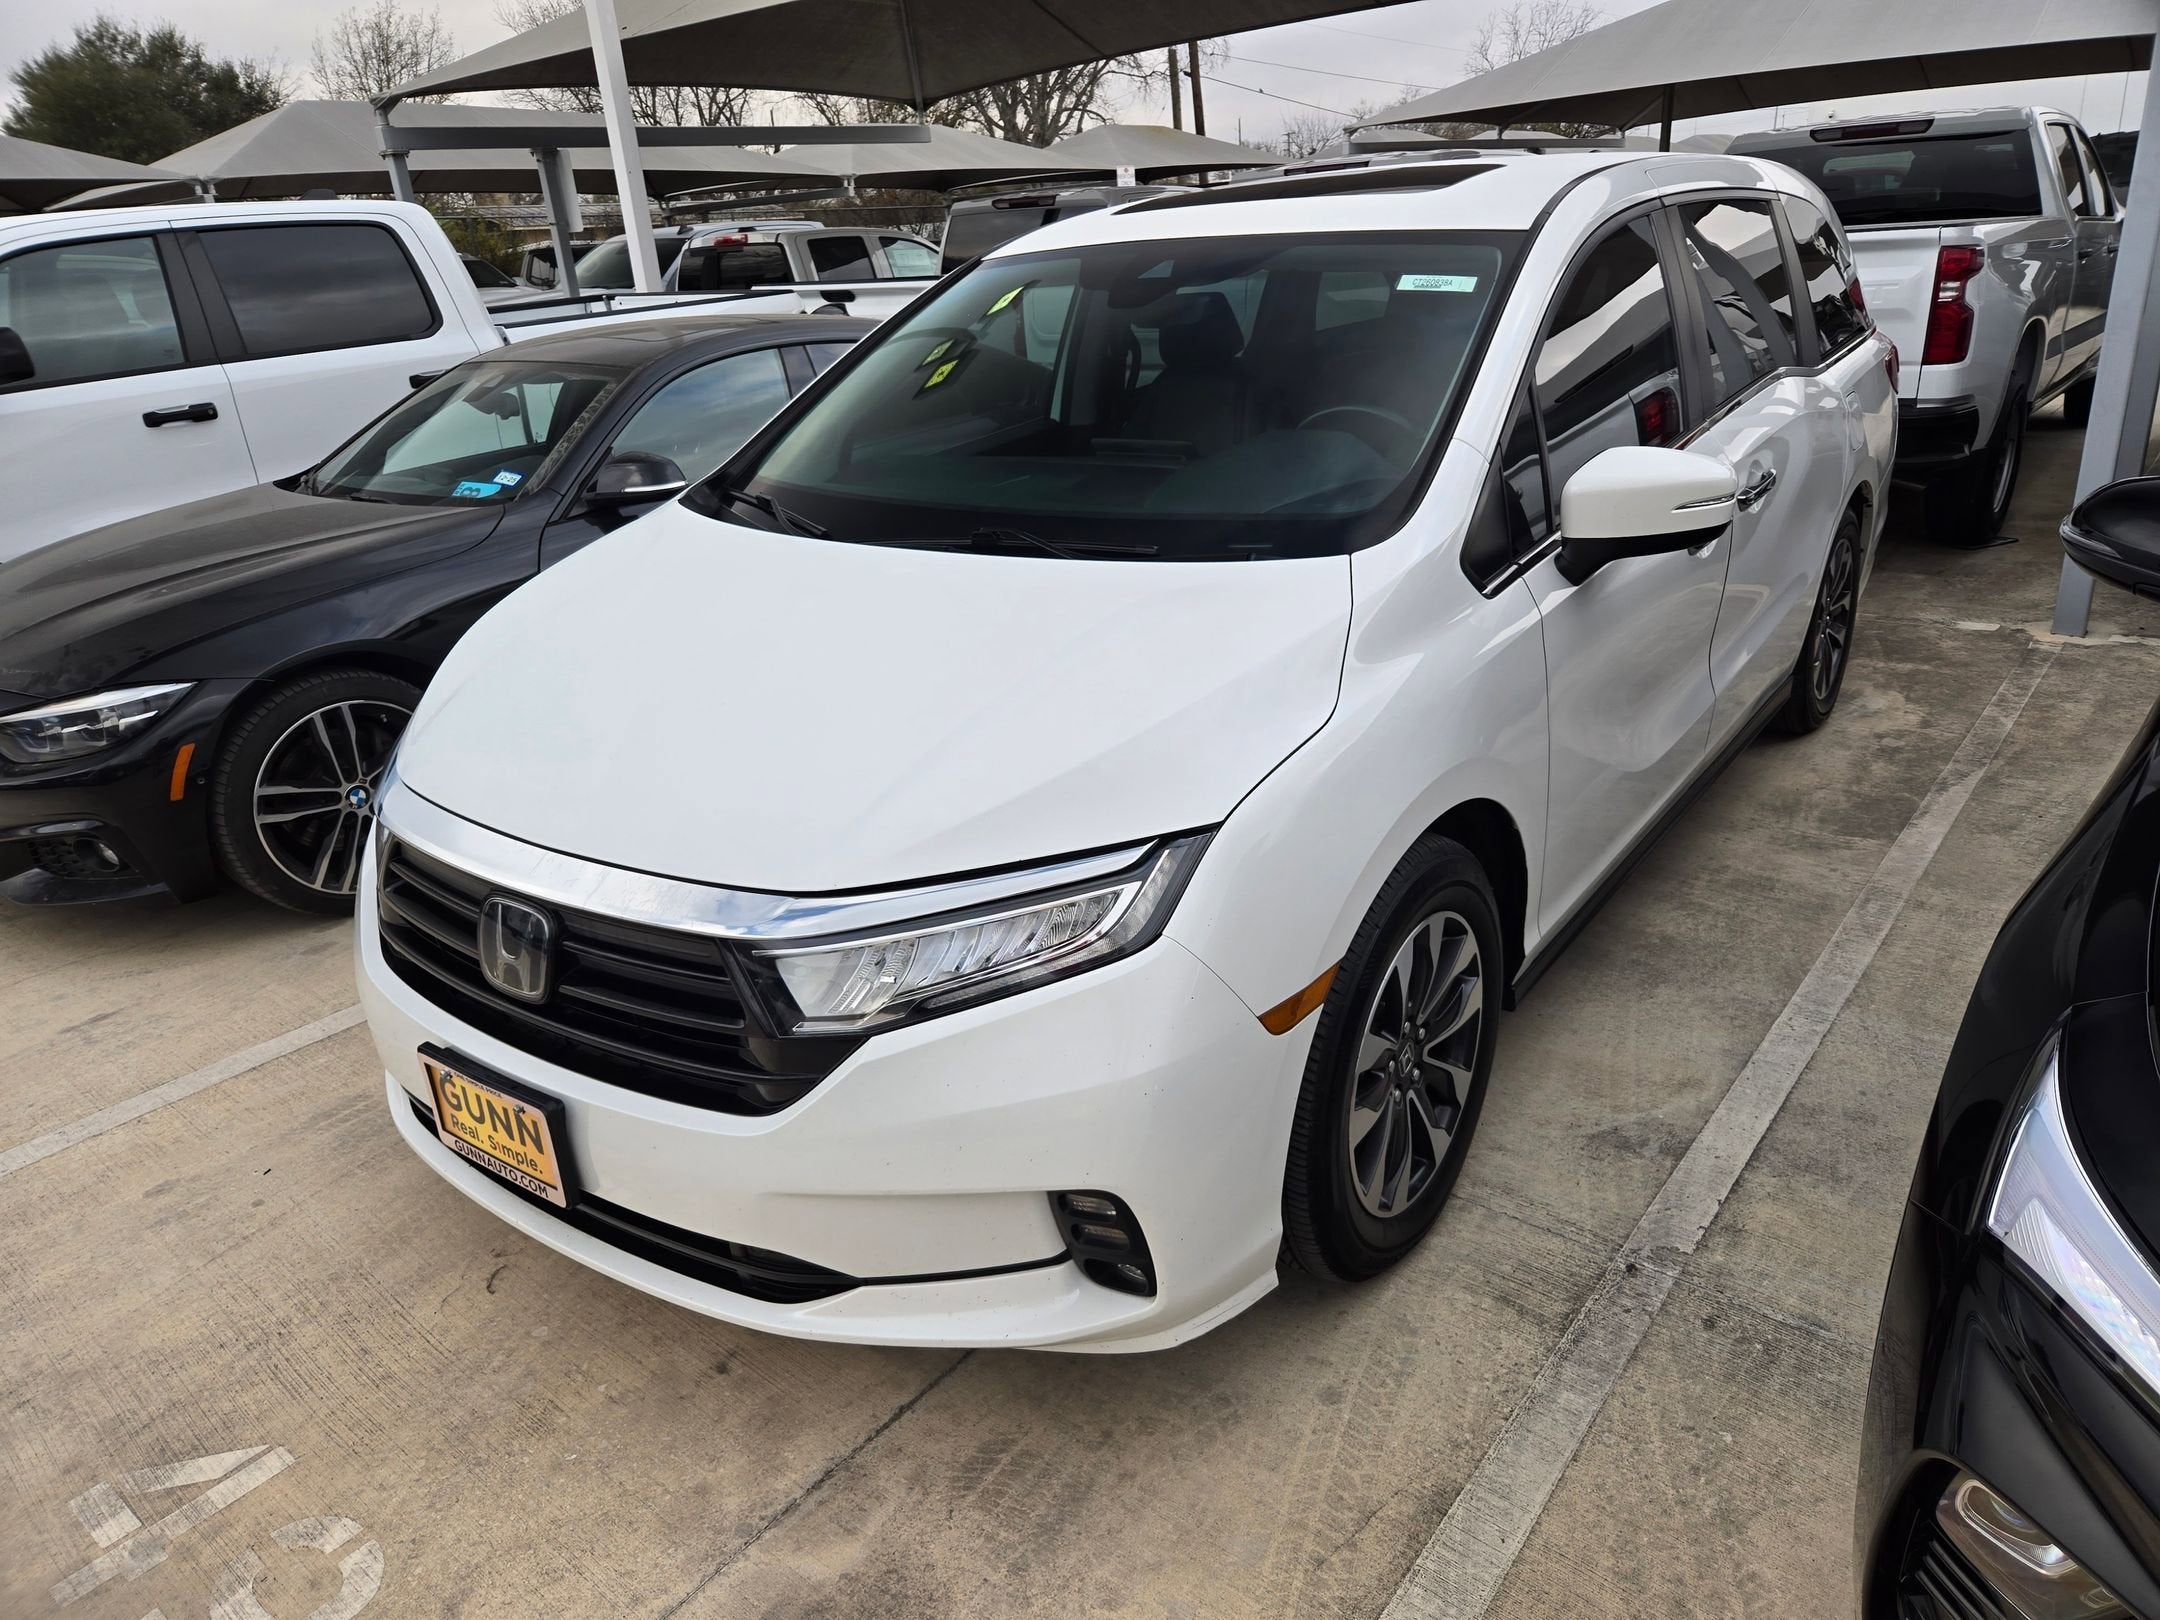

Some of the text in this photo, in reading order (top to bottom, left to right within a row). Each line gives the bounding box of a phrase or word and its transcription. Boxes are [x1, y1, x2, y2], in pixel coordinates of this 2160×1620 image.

[440, 1075, 545, 1155] GUNN
[451, 1113, 484, 1144] Real.
[454, 1139, 549, 1198] GUNNAUTO.COM
